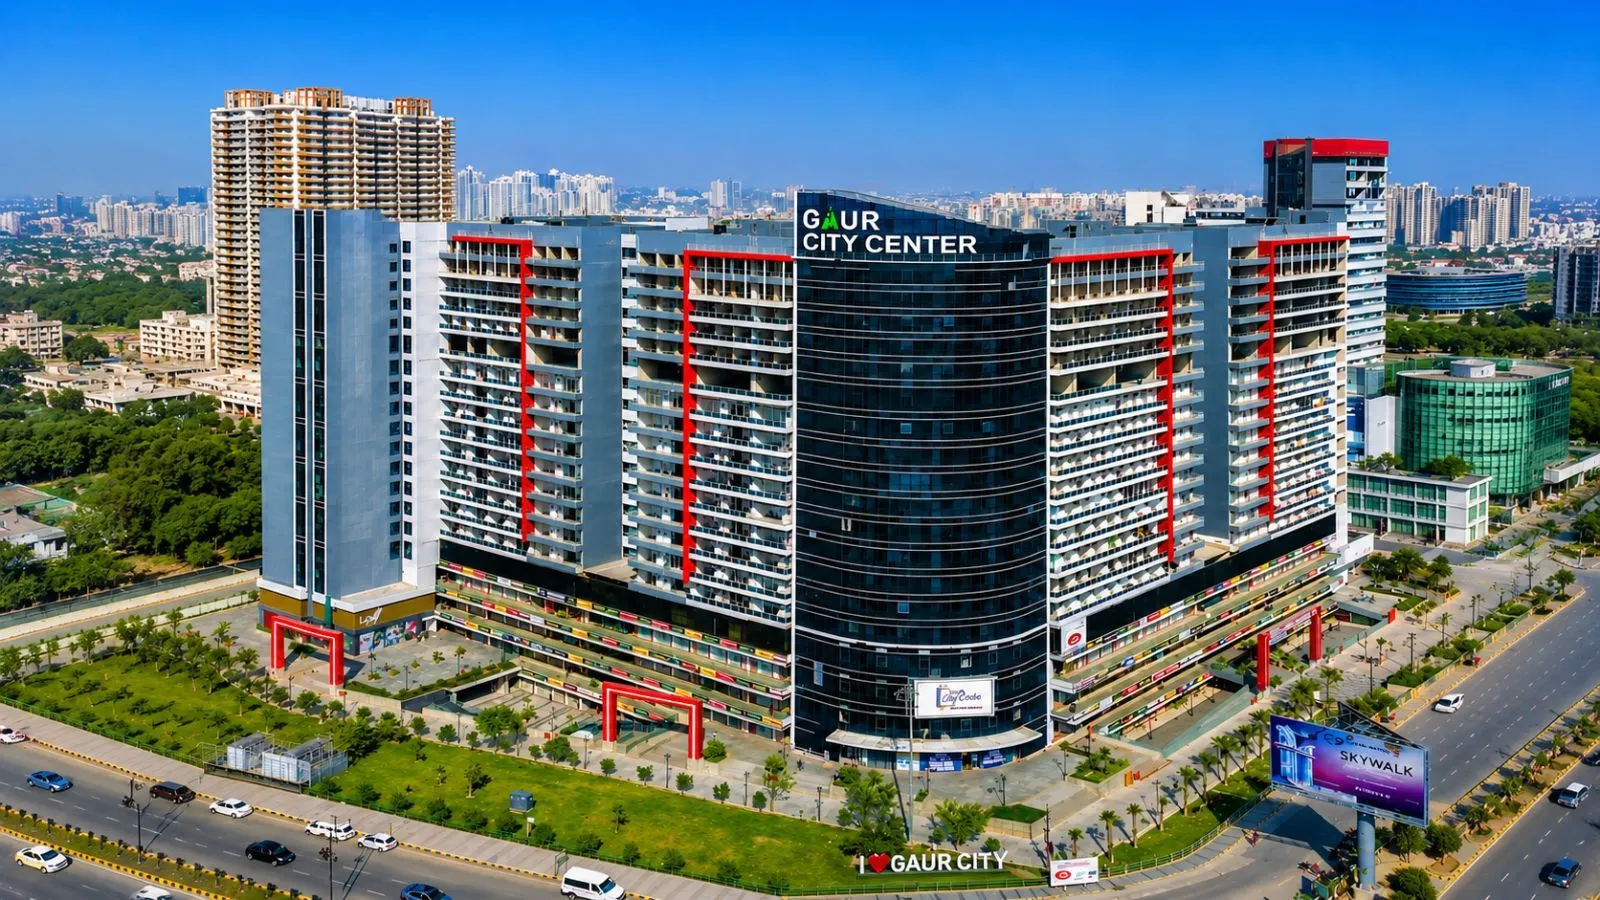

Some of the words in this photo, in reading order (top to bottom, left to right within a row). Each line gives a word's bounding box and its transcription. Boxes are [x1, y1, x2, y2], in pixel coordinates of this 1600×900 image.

[803, 208, 880, 231] GAUR
[803, 233, 858, 252] CITY
[865, 235, 977, 254] CENTER
[1340, 750, 1413, 777] SKYWALK
[859, 855, 864, 874] I
[890, 853, 952, 873] GAUR
[957, 850, 1008, 871] CITY
